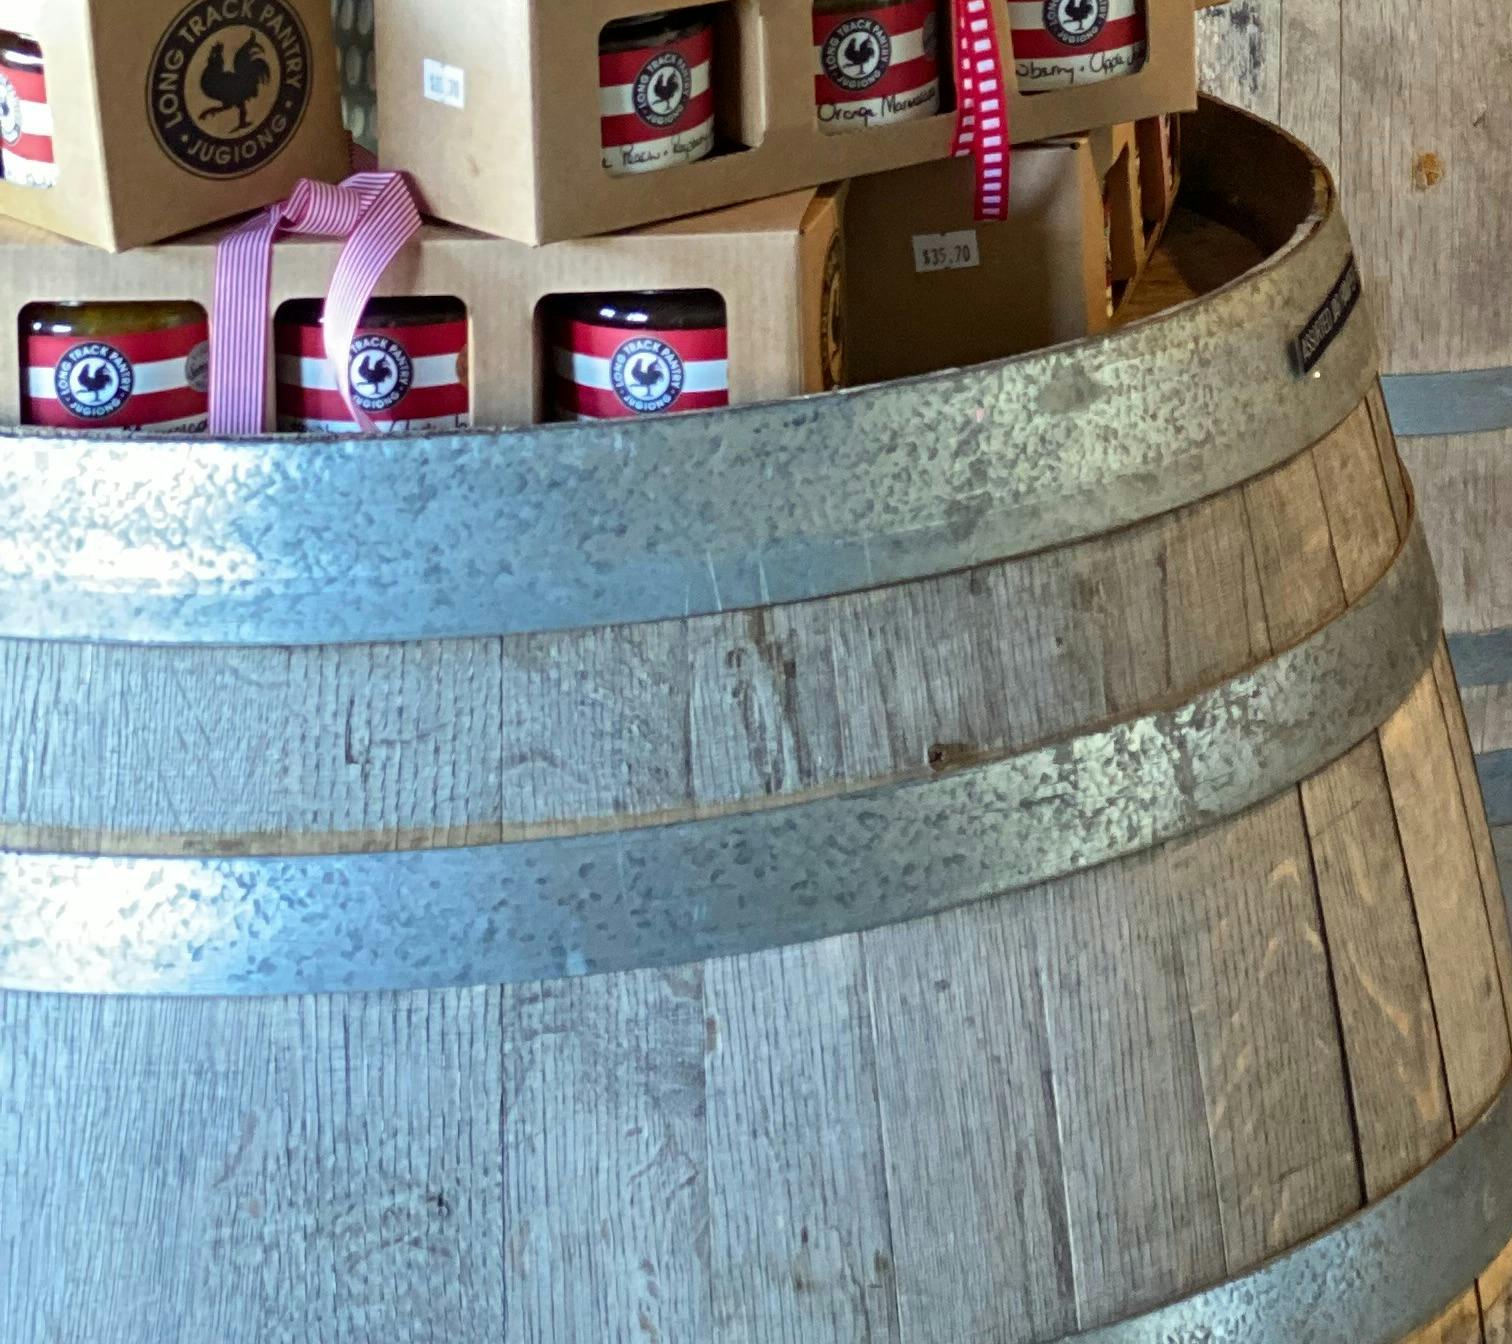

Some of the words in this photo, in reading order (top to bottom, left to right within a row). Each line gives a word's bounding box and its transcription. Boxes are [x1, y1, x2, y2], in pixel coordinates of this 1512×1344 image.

[158, 49, 184, 129] LONG
[260, 4, 303, 89] PANTRY
[826, 37, 839, 71] LONG
[837, 18, 873, 36] TRACK
[636, 73, 649, 109] LONG
[648, 53, 677, 72] TRACK
[186, 114, 288, 164] JUGIONG
[922, 244, 971, 267] $35.70
[59, 361, 73, 396] LONG
[69, 344, 110, 362] TRACK
[109, 347, 131, 393] PANTRY
[352, 336, 388, 354] TRACK
[612, 352, 627, 388] LONG
[623, 339, 660, 355] TRACK
[661, 343, 683, 389] PANTRY
[70, 397, 122, 417] JUGIONG
[624, 394, 672, 411] JUGIONG
